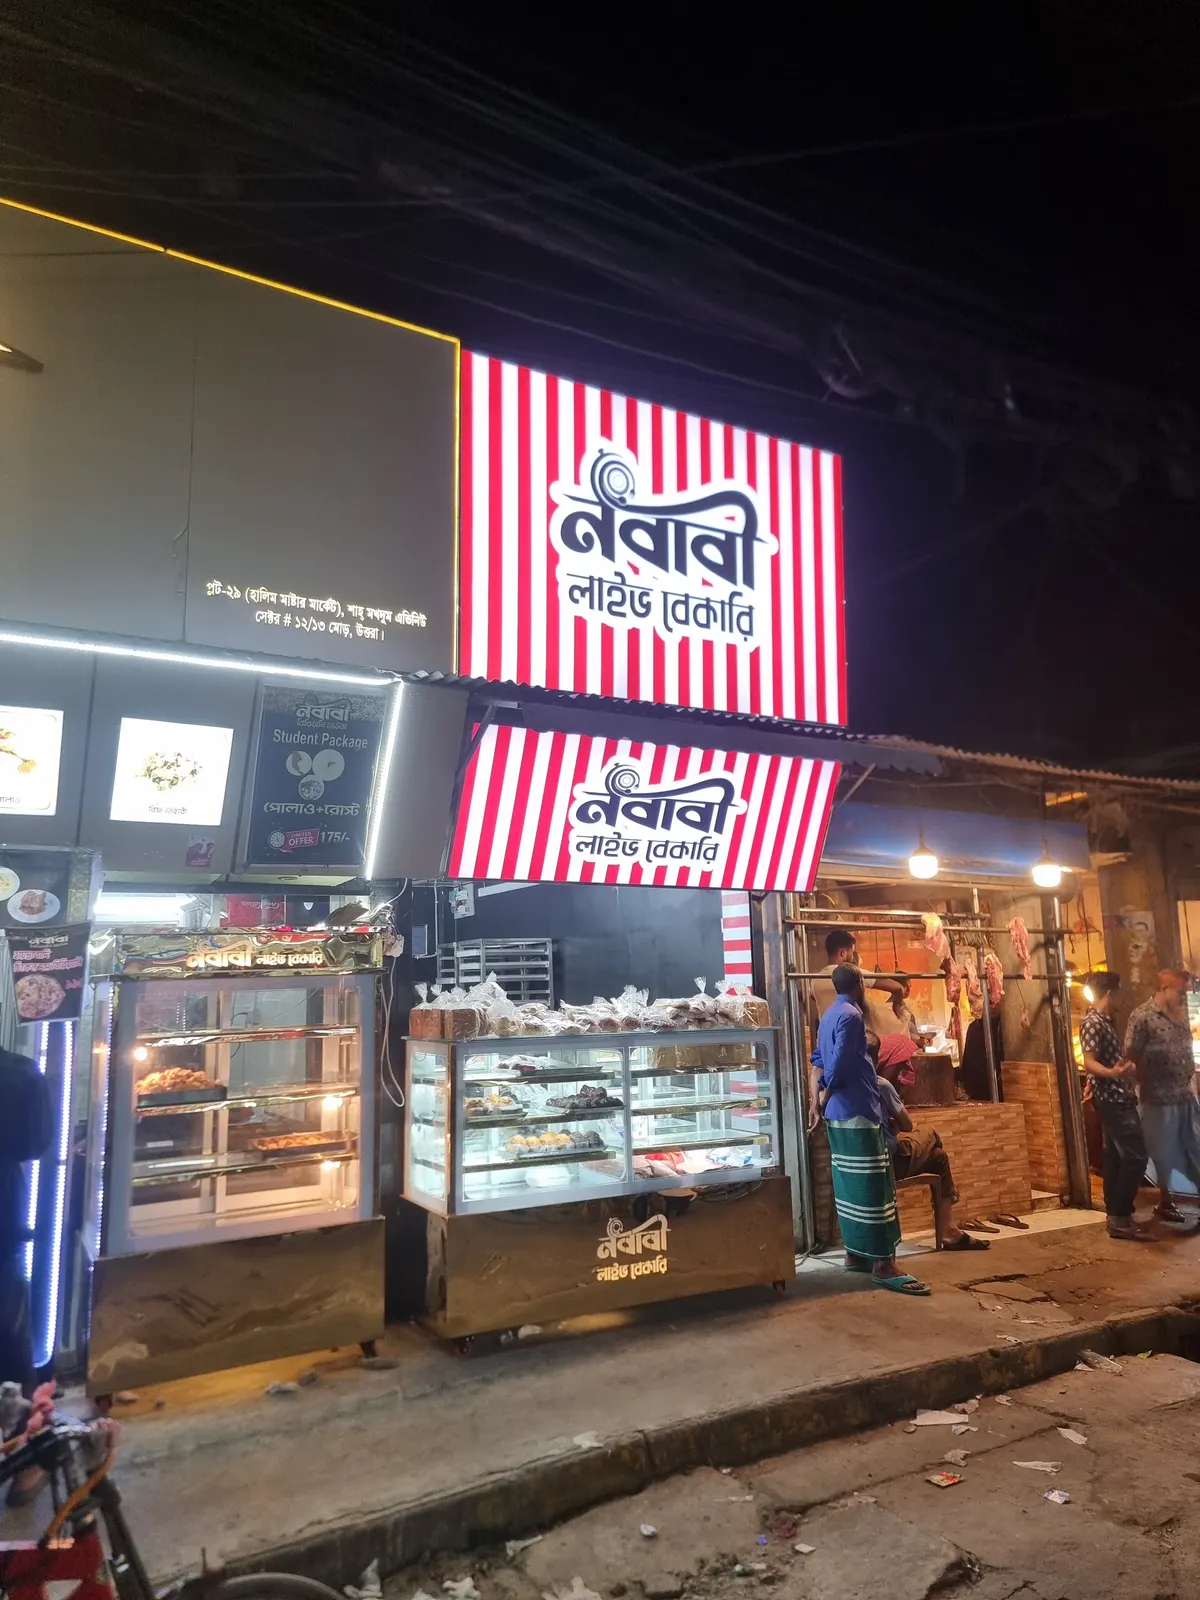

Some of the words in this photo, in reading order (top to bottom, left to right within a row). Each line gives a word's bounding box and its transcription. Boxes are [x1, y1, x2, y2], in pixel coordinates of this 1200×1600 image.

[560, 449, 769, 591] নবাবী
[566, 571, 654, 619] লাইভ
[661, 591, 755, 642] বেকারি
[283, 613, 292, 627] #
[295, 616, 326, 633] ১২/১৩
[295, 693, 354, 722] নবাবী
[273, 728, 319, 746] Student
[321, 732, 369, 751] Package
[575, 763, 741, 835] নবাবী
[288, 836, 314, 846] OFFER
[320, 831, 350, 844] 175/-
[576, 832, 643, 857] লাইভ
[646, 836, 721, 865] বেকারি
[186, 938, 255, 968] নবাবী
[256, 952, 287, 966] লাইভ
[288, 949, 324, 967] বেকারি
[597, 1213, 672, 1260] নবাবী
[596, 1262, 629, 1281] লাইভ
[631, 1255, 668, 1280] বেকারি
